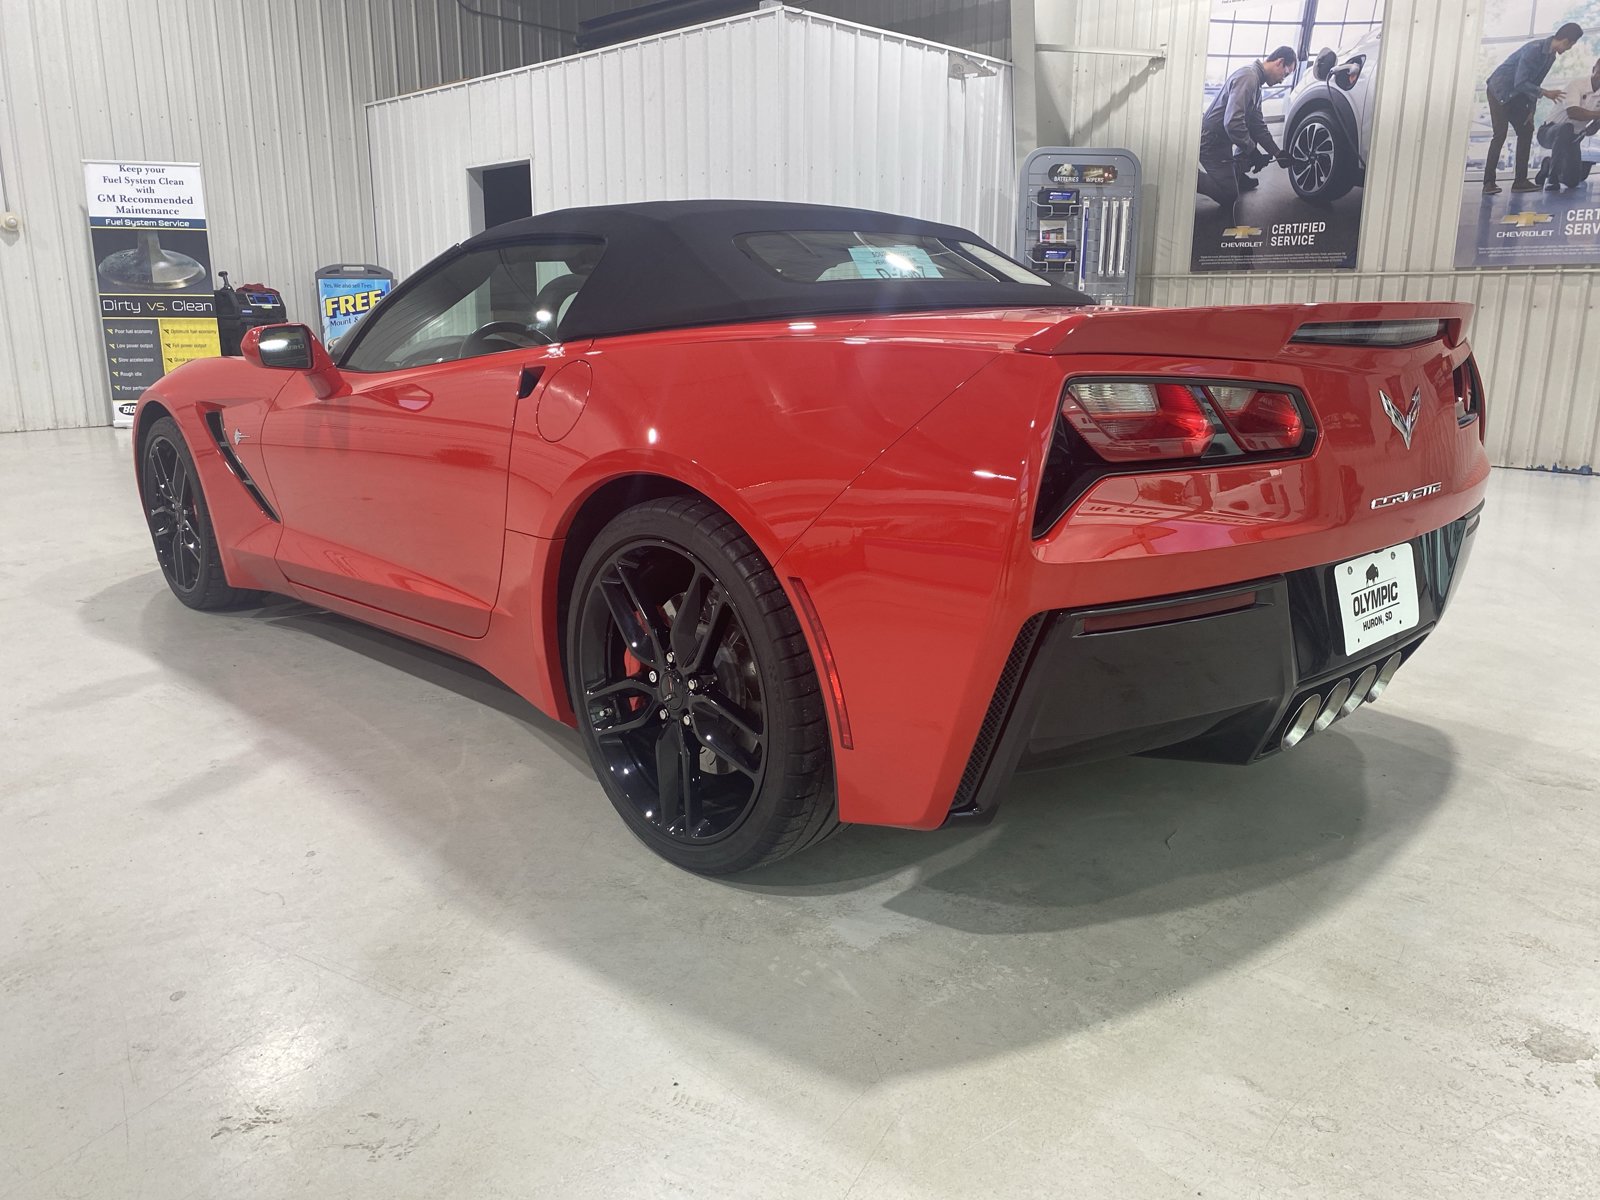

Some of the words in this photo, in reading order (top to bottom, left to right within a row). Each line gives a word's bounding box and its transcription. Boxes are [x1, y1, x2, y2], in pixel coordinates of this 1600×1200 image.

[119, 164, 142, 175] Keep
[145, 167, 165, 175] your
[103, 175, 122, 184] Fuel
[124, 176, 156, 186] System
[158, 177, 184, 186] Clean
[136, 186, 155, 194] with
[97, 194, 116, 203] GM
[119, 194, 194, 205] Recommended
[115, 205, 180, 216] Maintenance
[105, 218, 123, 226] Fuel
[124, 219, 157, 227] System
[158, 219, 190, 228] Service
[1271, 221, 1326, 235] CERTIFIED
[1496, 229, 1555, 238] CHEVROLET
[1270, 234, 1315, 247] SERVICE
[102, 299, 141, 314] Dirty
[146, 301, 168, 311] vs.
[171, 300, 213, 312] Clean
[325, 289, 382, 317] FREE
[330, 318, 352, 327] Mount
[1370, 482, 1442, 510] CORVETTE
[1353, 581, 1399, 617] OLYMPIC
[1362, 614, 1385, 632] HURON,
[1385, 611, 1393, 622] SD
